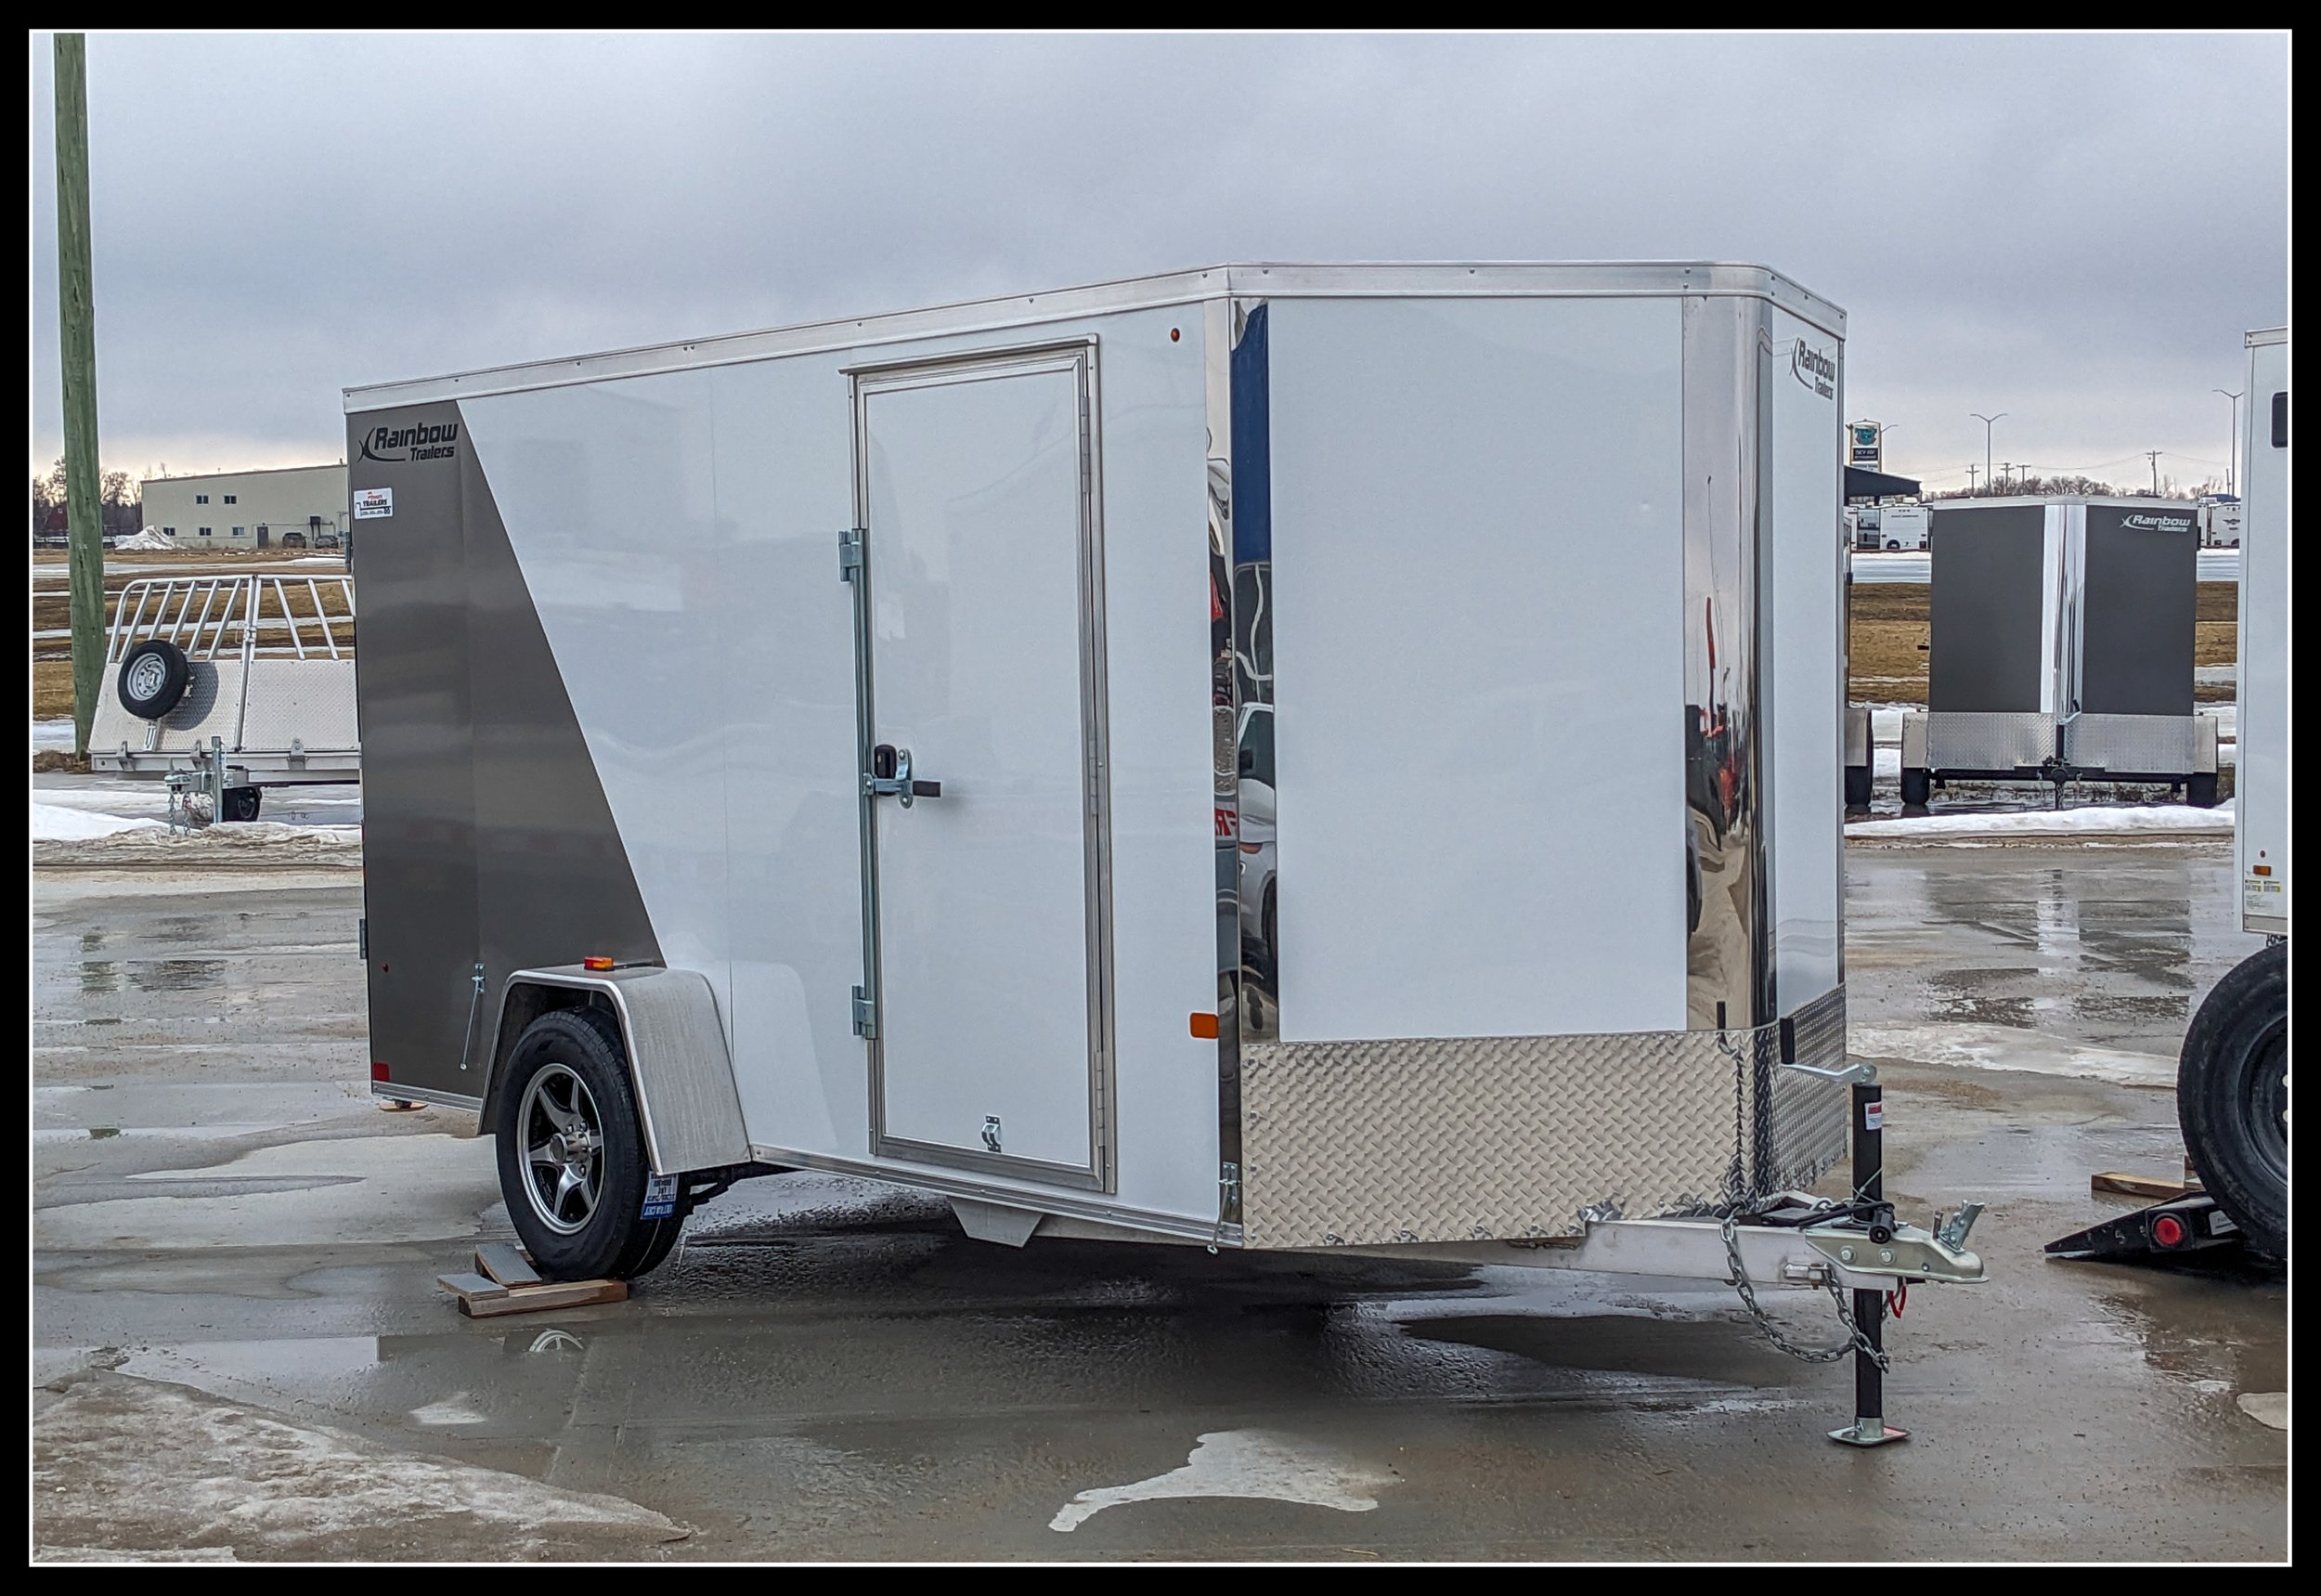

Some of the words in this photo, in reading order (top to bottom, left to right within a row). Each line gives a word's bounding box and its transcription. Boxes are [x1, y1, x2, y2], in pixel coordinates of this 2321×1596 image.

[1797, 340, 1835, 383] Rainbow
[374, 422, 459, 450] Rainbow
[409, 446, 455, 461] Trailers
[2133, 514, 2191, 527] Rainbow
